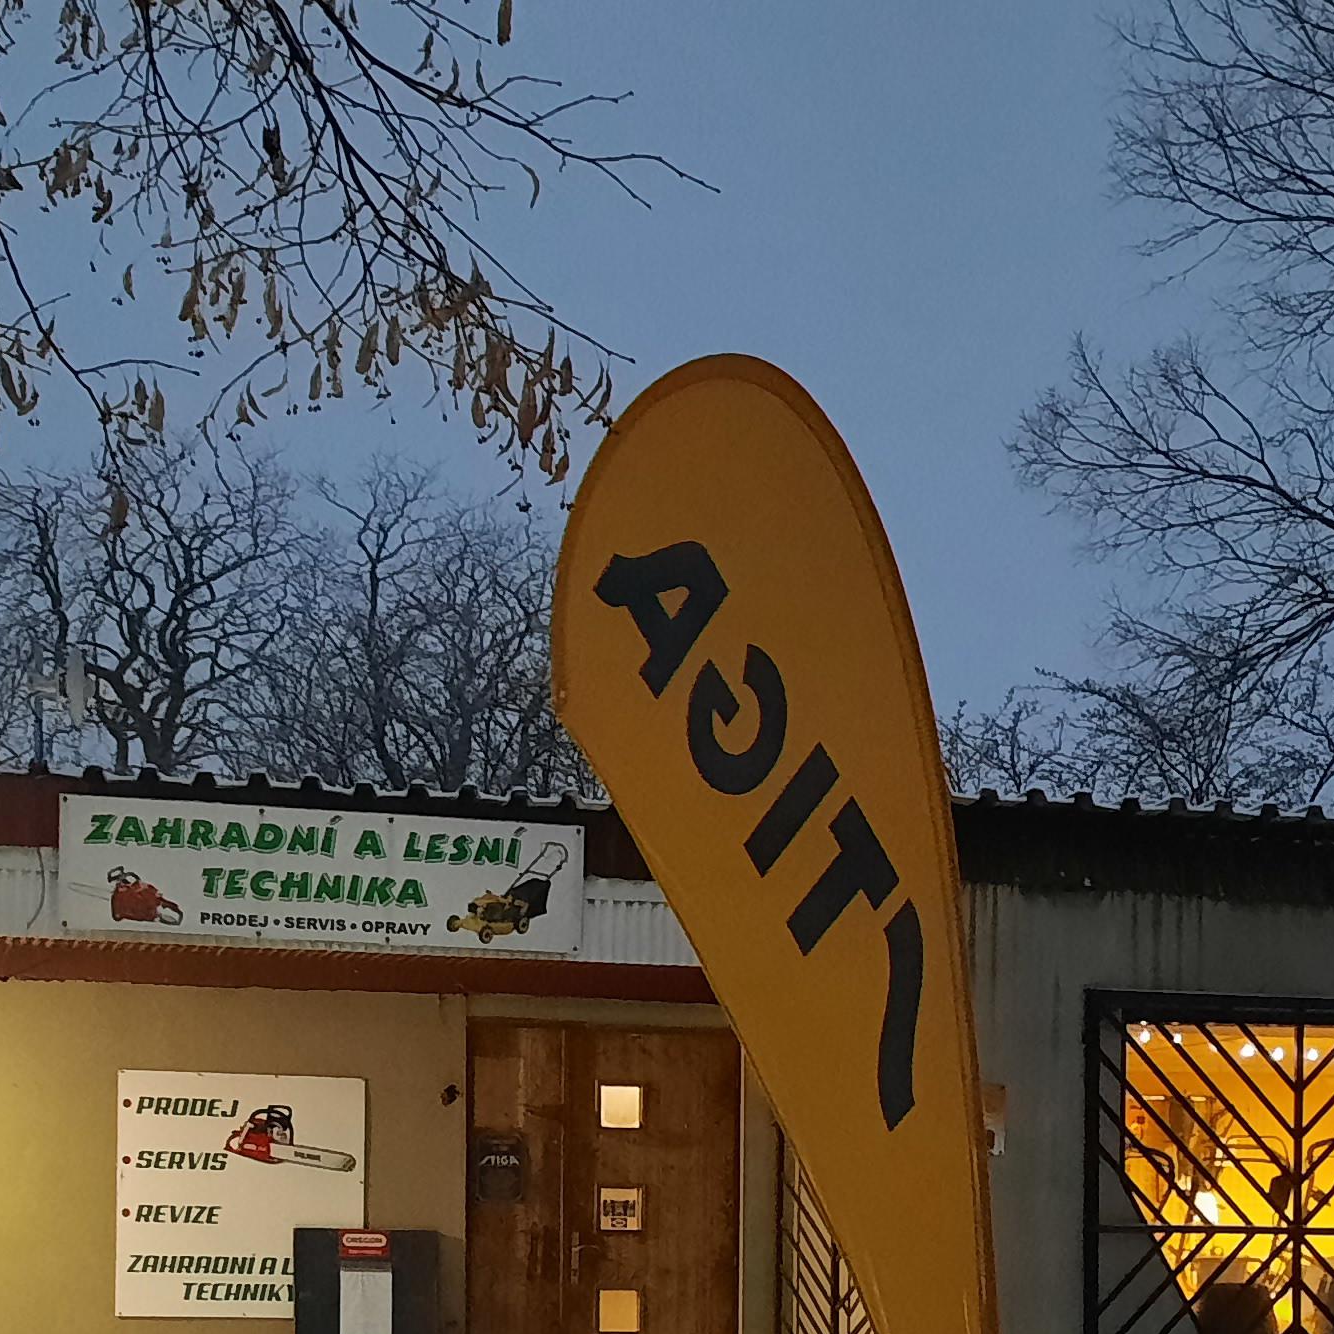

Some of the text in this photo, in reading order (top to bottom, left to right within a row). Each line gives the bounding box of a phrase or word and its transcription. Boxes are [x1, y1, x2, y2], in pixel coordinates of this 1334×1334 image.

[84, 814, 527, 868] ZAHRADNÍ A LESNÍ
[201, 867, 428, 908] TECHNIKA
[200, 912, 431, 936] PRODEJ SERVIS OPRAVY
[136, 1096, 239, 1117] PRODEJ
[136, 1151, 228, 1171] SERVIS
[135, 1205, 222, 1224] REVIZE
[127, 1253, 255, 1275] ZAHRADNÍ
[259, 1257, 278, 1275] A
